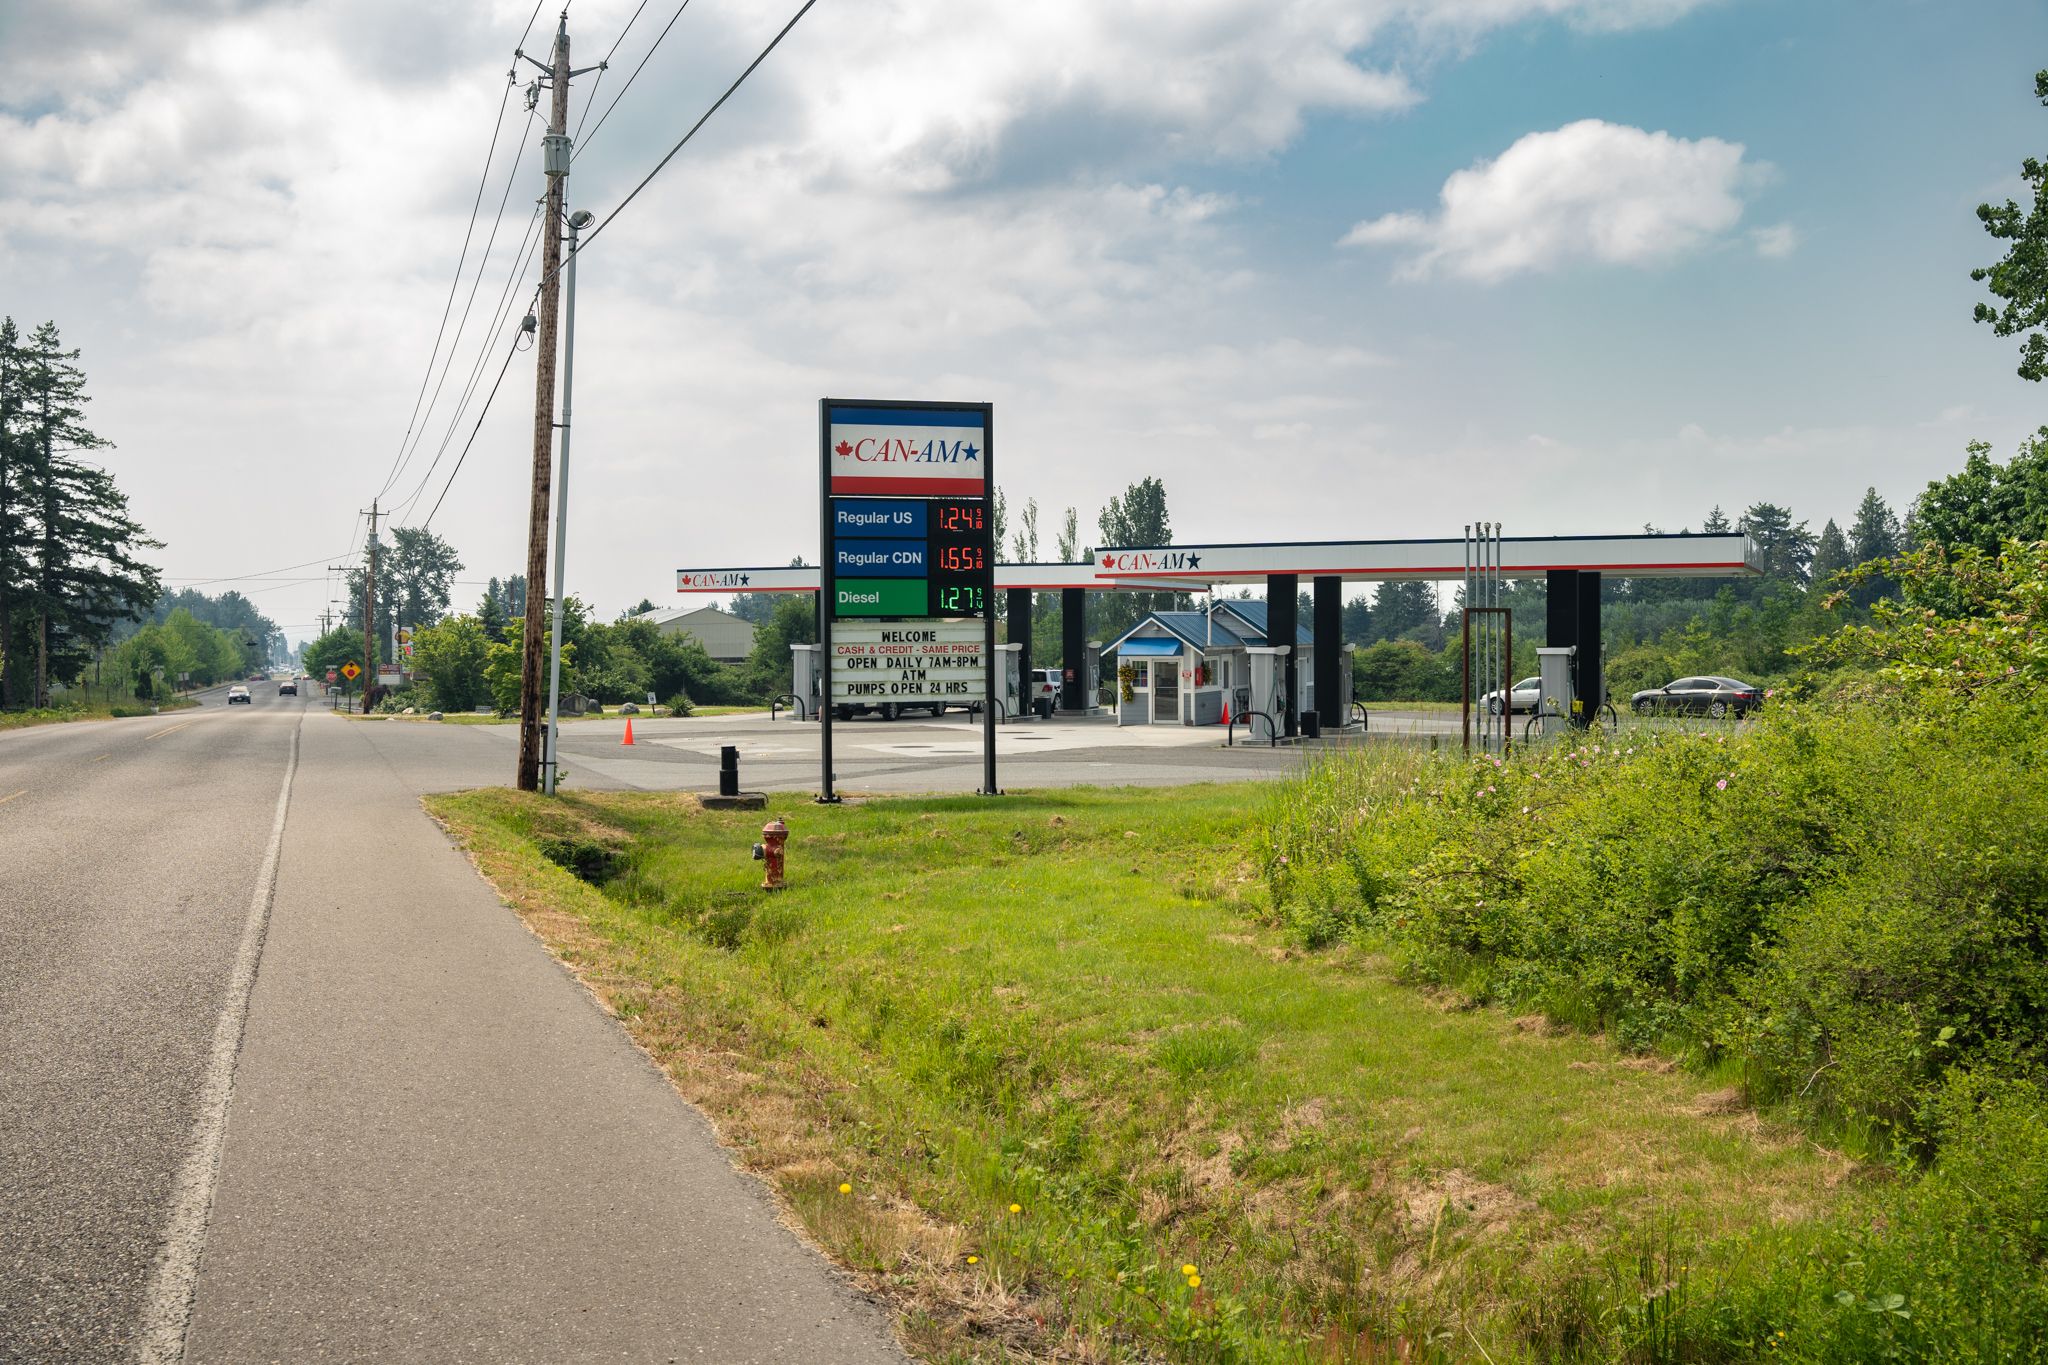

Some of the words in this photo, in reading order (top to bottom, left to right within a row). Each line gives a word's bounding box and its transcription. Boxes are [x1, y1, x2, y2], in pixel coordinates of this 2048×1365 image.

[854, 438, 964, 462] CAN-AM
[838, 511, 890, 526] Regular
[894, 512, 912, 524] US
[939, 508, 973, 530] 1.24
[838, 552, 890, 566] Regular
[892, 552, 922, 564] CDN
[940, 548, 973, 570] 1.65
[1117, 552, 1186, 570] CAN-AM
[692, 574, 740, 586] CAN-AM
[838, 592, 880, 604] Diesel
[940, 588, 973, 610] 1.27
[882, 631, 936, 642] WELCOME
[838, 646, 864, 654] CASH
[878, 646, 912, 654] CREDIT
[922, 645, 948, 653] SAME
[952, 645, 980, 653] PRICE
[848, 658, 877, 668] OPEN
[887, 657, 922, 668] DAILY
[929, 656, 978, 667] 7AM-8PM
[902, 670, 926, 680] ATM
[848, 683, 885, 694] PUMPS
[891, 682, 922, 694] OPEN
[930, 682, 940, 693] 24
[946, 682, 968, 693] HRS
